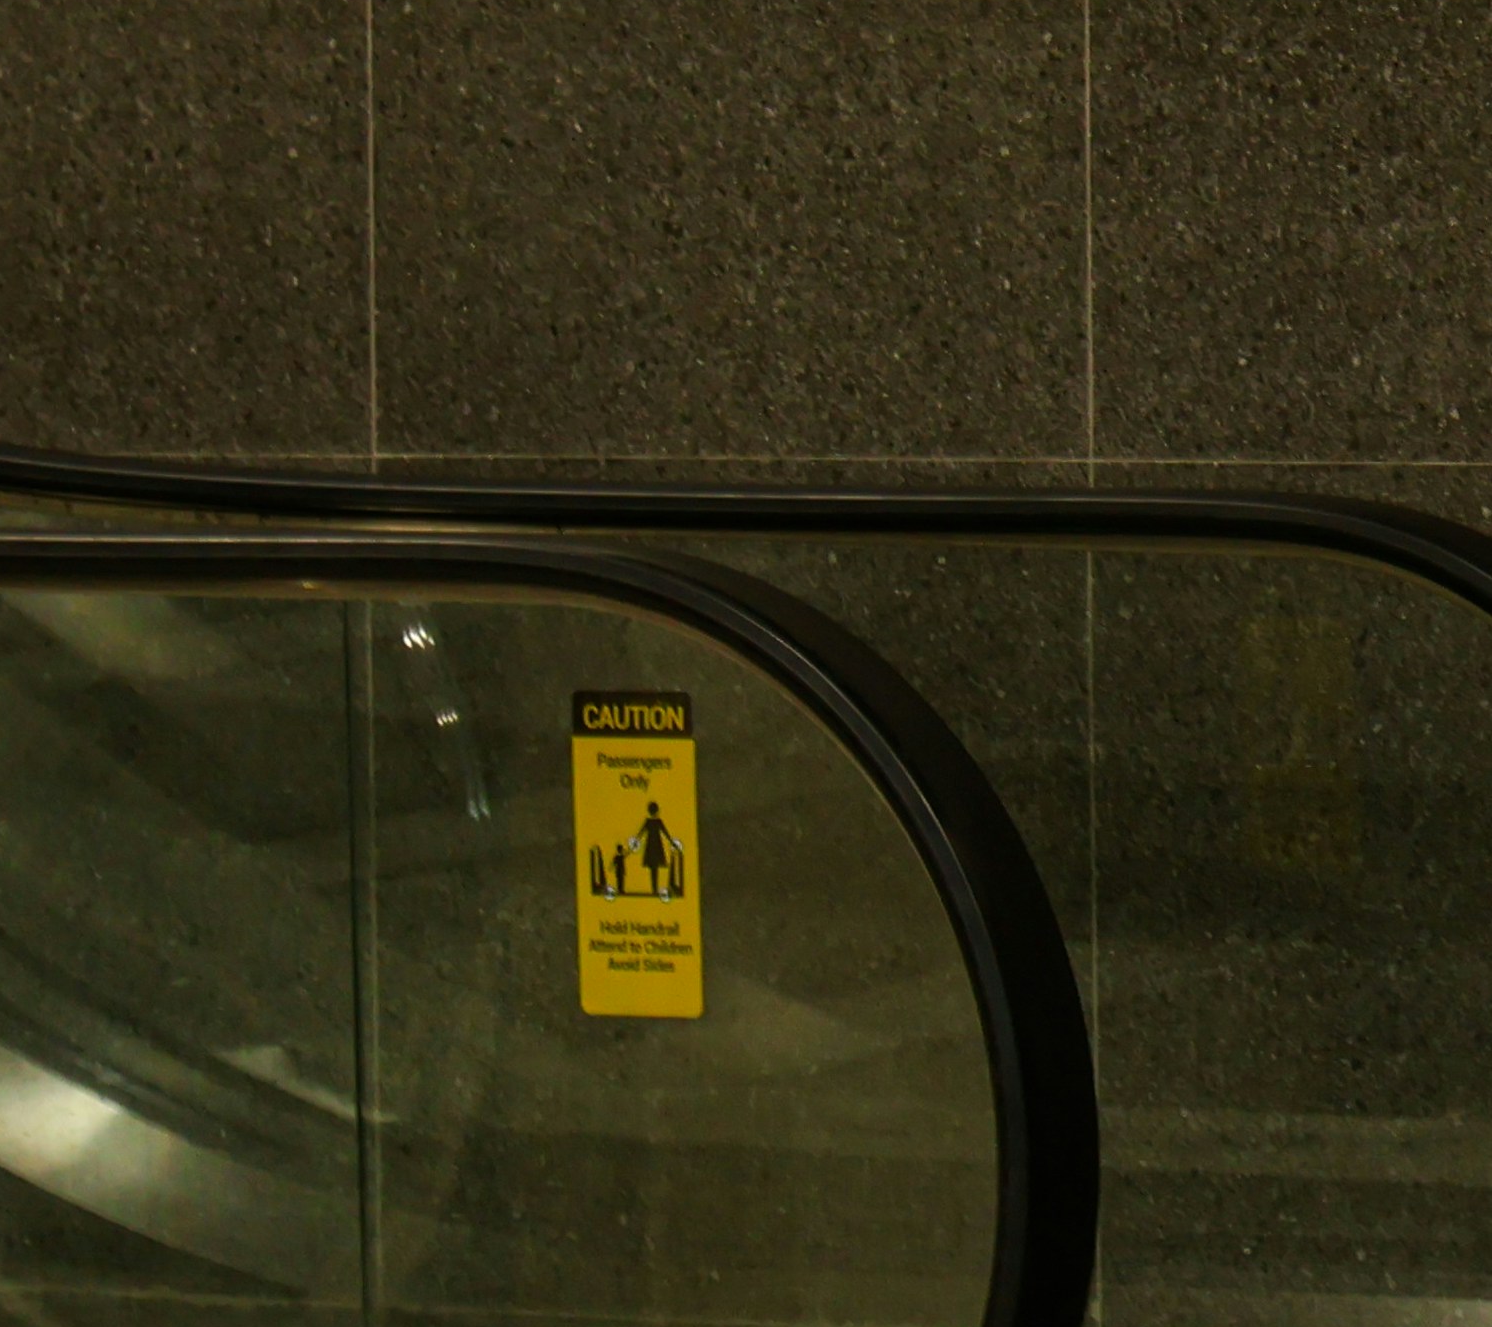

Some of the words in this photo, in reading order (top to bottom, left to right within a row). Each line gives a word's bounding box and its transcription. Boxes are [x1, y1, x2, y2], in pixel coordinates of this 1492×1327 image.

[583, 704, 684, 731] CAUTION
[597, 752, 672, 772] Passengers
[619, 773, 650, 792] Only
[601, 921, 628, 935] Hold
[631, 921, 679, 936] Handrail
[590, 939, 627, 952] Attend
[630, 941, 642, 953] to
[646, 939, 692, 954] Children
[609, 958, 640, 971] Avoid
